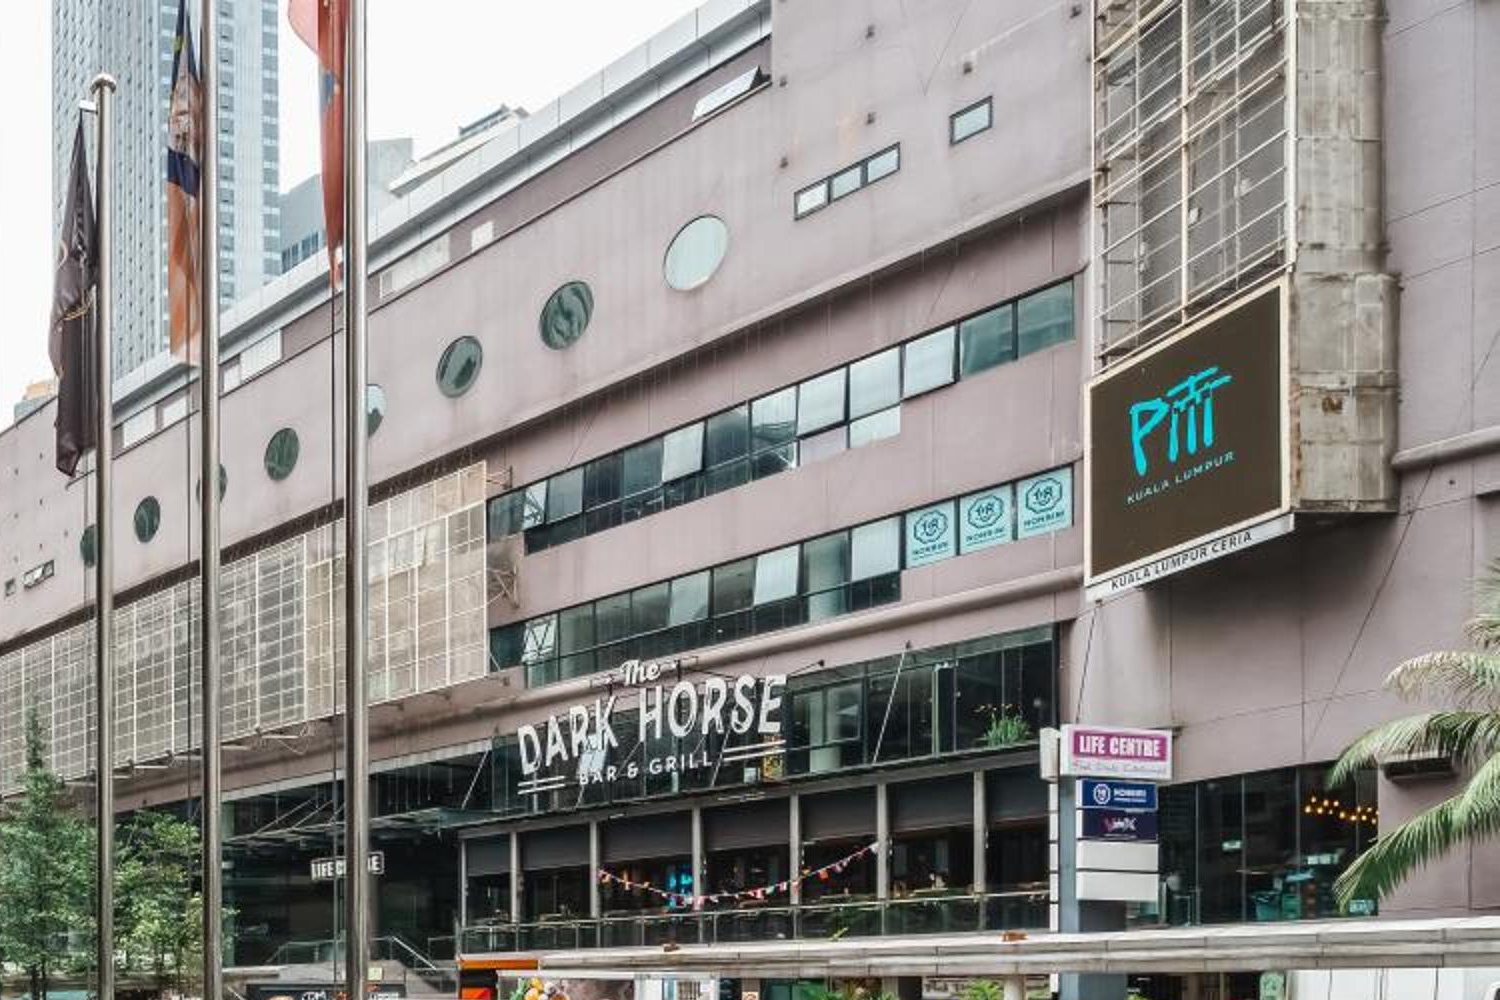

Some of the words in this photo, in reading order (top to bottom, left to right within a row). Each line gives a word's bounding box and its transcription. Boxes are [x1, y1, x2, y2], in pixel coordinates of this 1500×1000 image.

[1127, 479, 1169, 504] KUALA
[1175, 451, 1234, 483] LUMPUR
[1111, 568, 1151, 591] KUALA
[1155, 549, 1207, 574] LUMPUR
[1211, 531, 1253, 553] CERIA
[620, 660, 660, 685] The
[518, 695, 618, 774] DARK
[639, 674, 786, 743] HORSE
[1079, 735, 1106, 754] LIFE
[1109, 737, 1161, 757] CENTRE
[579, 765, 617, 785] BAR
[627, 761, 639, 779] &
[649, 751, 713, 775] GRILL
